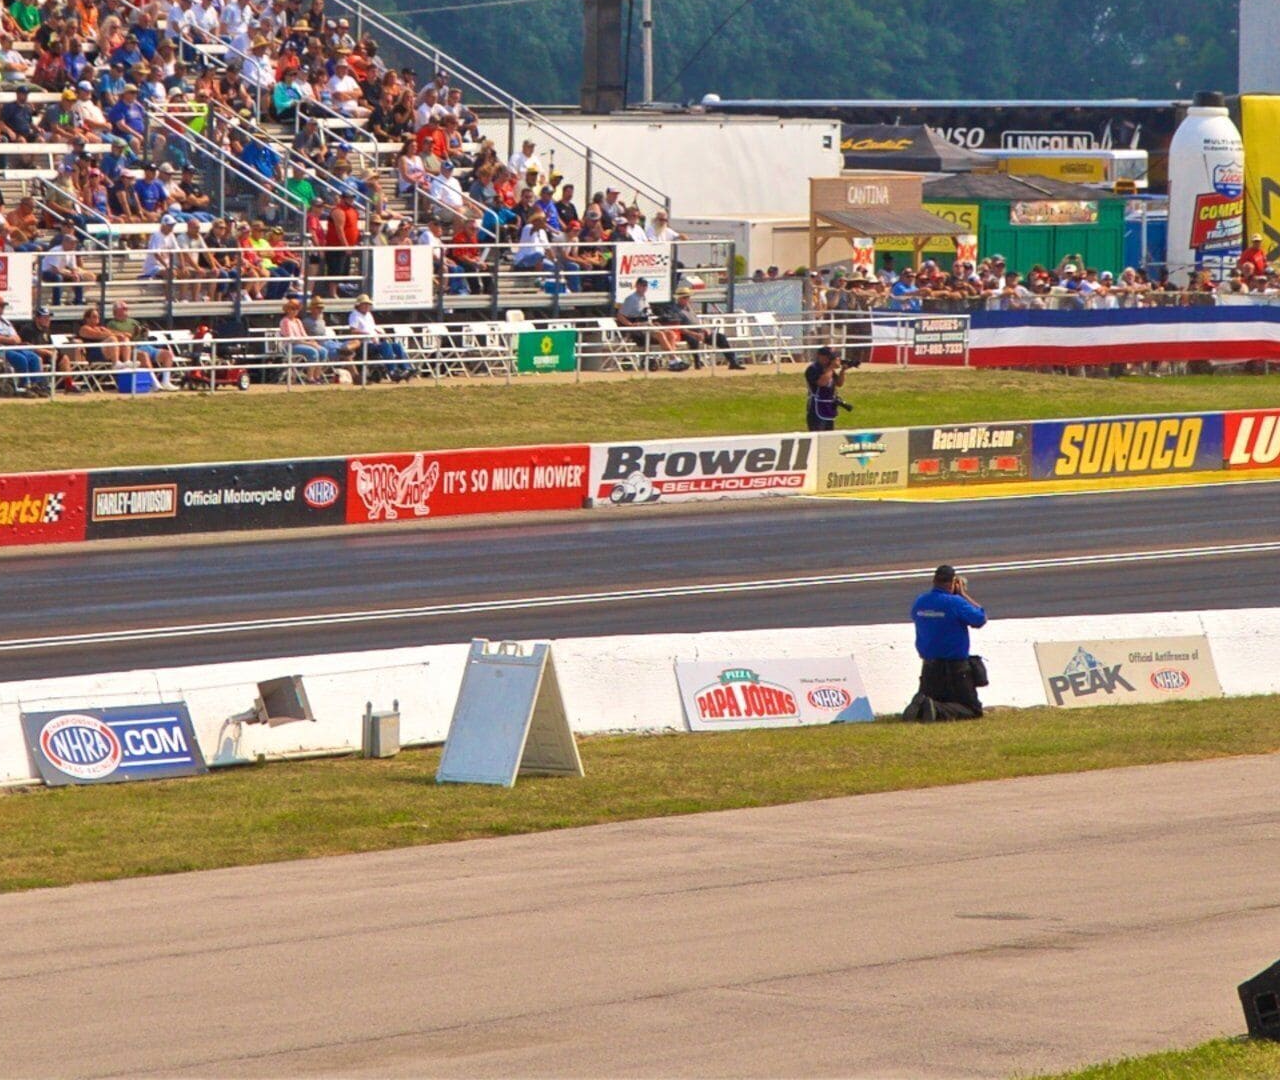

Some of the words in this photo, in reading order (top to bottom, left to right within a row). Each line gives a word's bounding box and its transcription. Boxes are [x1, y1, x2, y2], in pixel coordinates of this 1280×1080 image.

[1006, 135, 1088, 150] LINCOLN
[847, 184, 890, 205] CANTINA
[932, 427, 1015, 453] RacingRVs.com
[1055, 418, 1203, 476] SUNOCO
[602, 438, 812, 481] Browell
[443, 470, 467, 494] IT'S
[470, 468, 489, 493] SO
[492, 467, 530, 492] MUCH
[532, 465, 583, 490] MOWER
[662, 475, 803, 494] BELLHOUSING
[96, 490, 173, 516] HARLEY-DAVIDSON
[184, 488, 222, 507] Official
[224, 486, 282, 507] Motorcycle
[283, 486, 296, 502] of
[307, 482, 338, 504] NHRA
[1129, 651, 1153, 663] Official
[1155, 651, 1190, 662] Antifreeze
[1192, 649, 1199, 661] of
[724, 670, 752, 680] PIZZA
[1048, 663, 1136, 706] PEAK
[698, 686, 742, 719] PAPA
[812, 689, 846, 709] NHRA
[54, 727, 110, 764] NHRA
